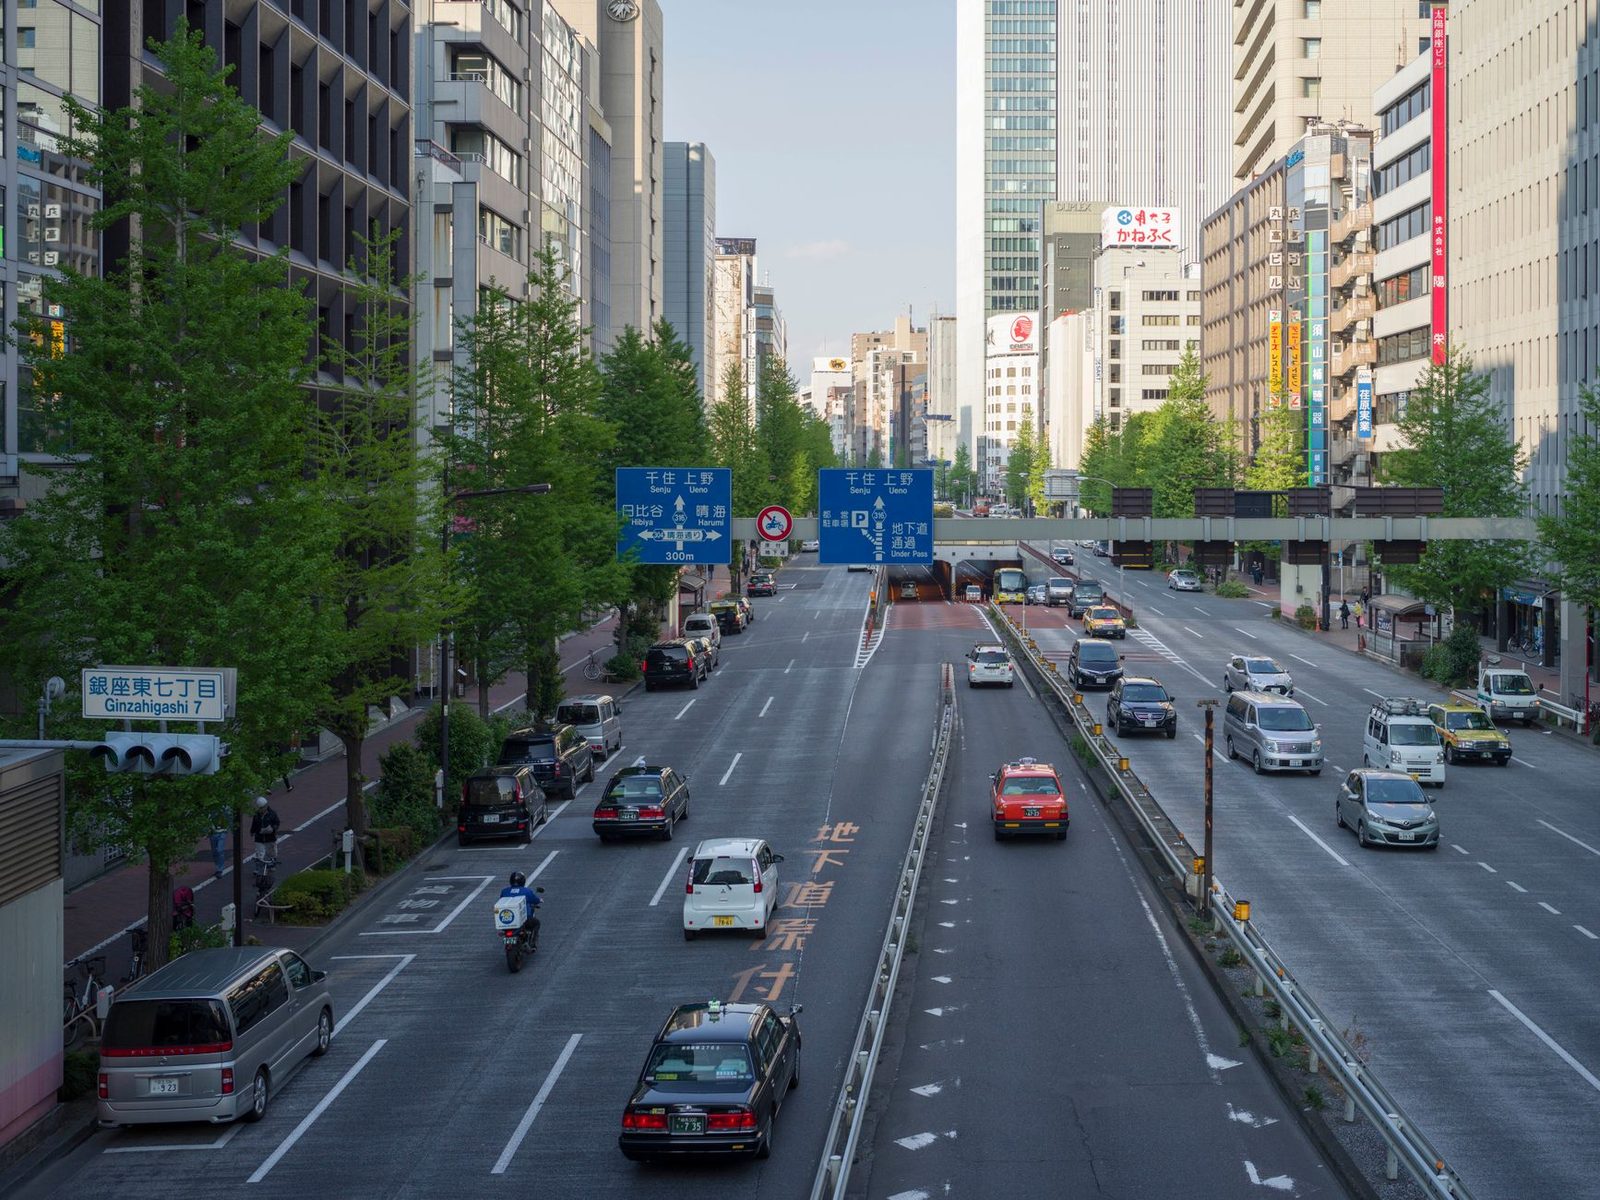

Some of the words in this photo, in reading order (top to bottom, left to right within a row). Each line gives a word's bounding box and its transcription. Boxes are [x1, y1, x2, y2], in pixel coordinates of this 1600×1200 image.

[1434, 9, 1444, 66] 太陽銀座ビル
[1135, 209, 1171, 226] 明太子
[1117, 228, 1172, 243] かねふく
[1434, 215, 1443, 256] 株式会社
[1271, 208, 1281, 287] 丸高ビル
[1359, 389, 1370, 432] 荏原実業
[645, 471, 676, 485] 千住
[684, 471, 714, 485] 上野
[845, 472, 876, 486] 千住
[883, 472, 914, 486] 上野
[650, 486, 671, 494] Senju
[689, 486, 708, 494] Ueno
[850, 486, 871, 495] Senju
[622, 504, 663, 517] 日比谷
[695, 504, 726, 518] 晴海
[822, 519, 849, 528] 駐車場
[855, 512, 866, 525] P
[891, 521, 928, 535] 地下道
[891, 536, 916, 549] 通過
[665, 552, 694, 561] 300m
[890, 550, 910, 558] Under
[912, 550, 928, 558] Pass
[88, 676, 216, 699] 銀座東七丁目
[104, 697, 189, 715] Ginzahigashi
[193, 700, 202, 714] 7
